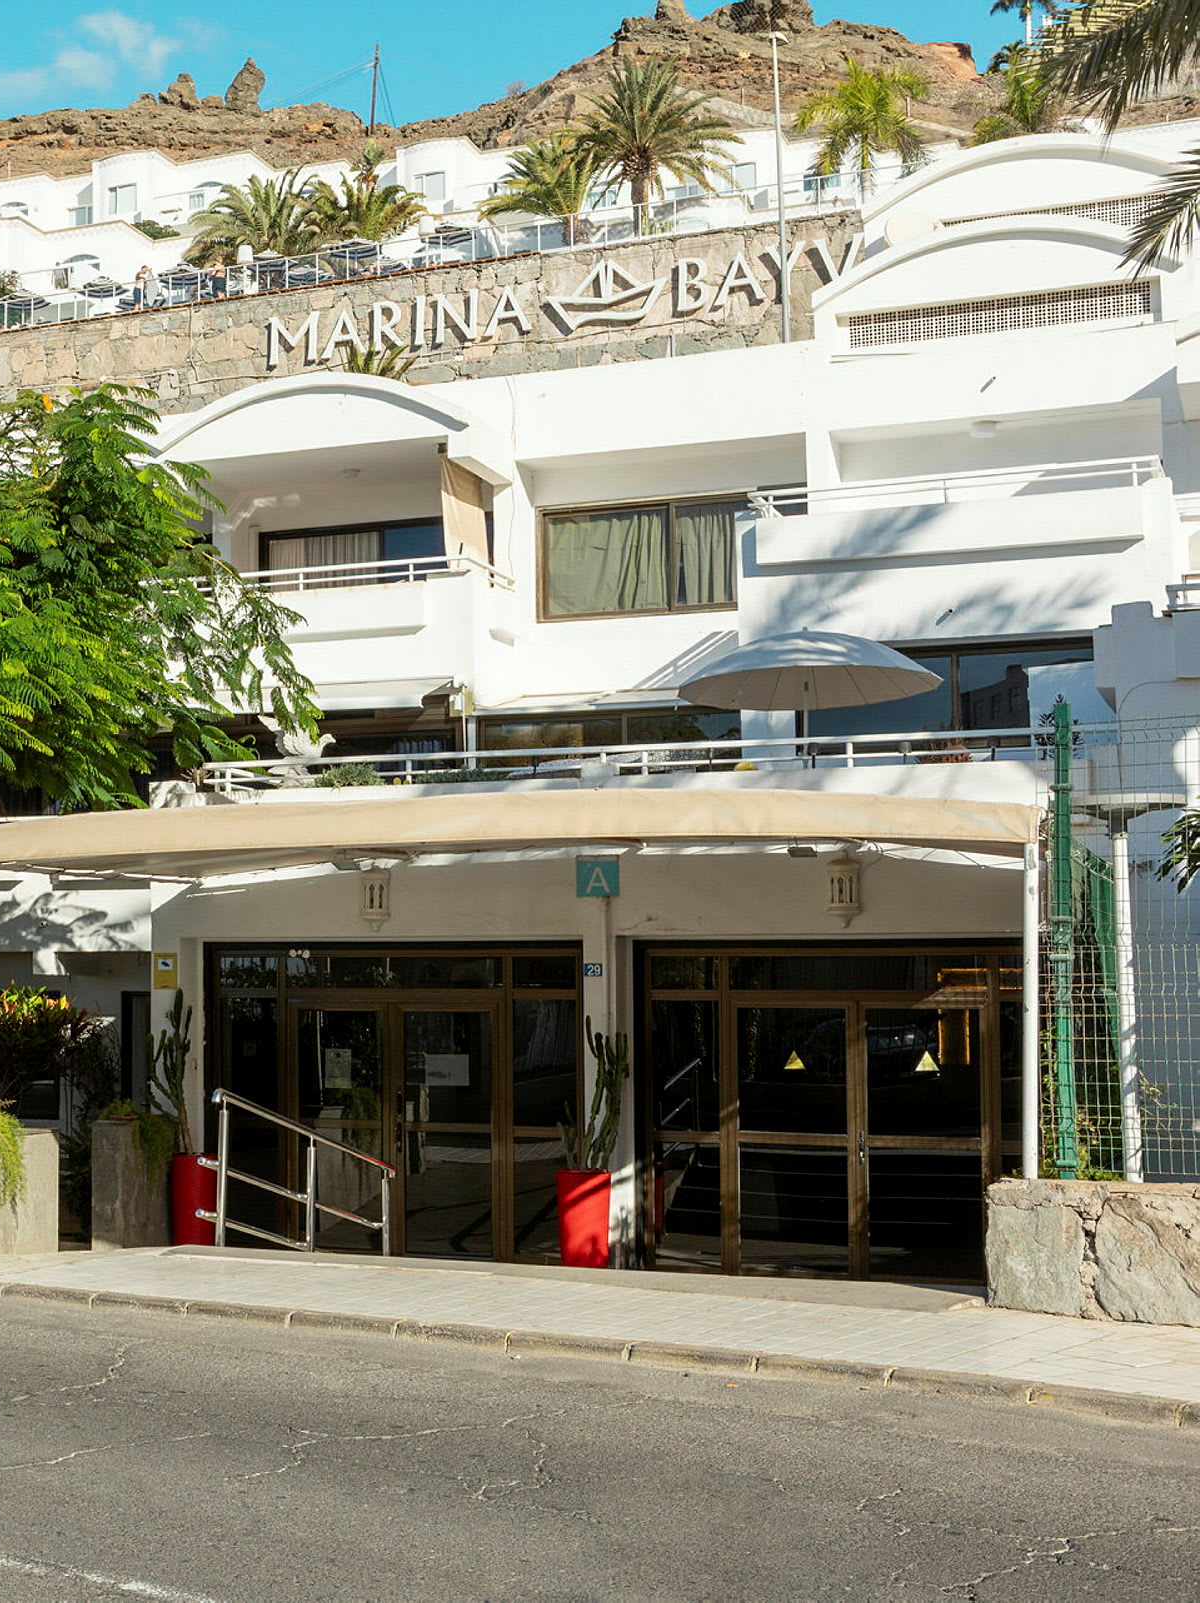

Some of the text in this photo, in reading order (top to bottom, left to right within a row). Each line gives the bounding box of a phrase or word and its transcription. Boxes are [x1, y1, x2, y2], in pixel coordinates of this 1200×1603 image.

[267, 285, 534, 367] MARINA
[585, 866, 611, 894] A
[587, 964, 601, 976] 29
